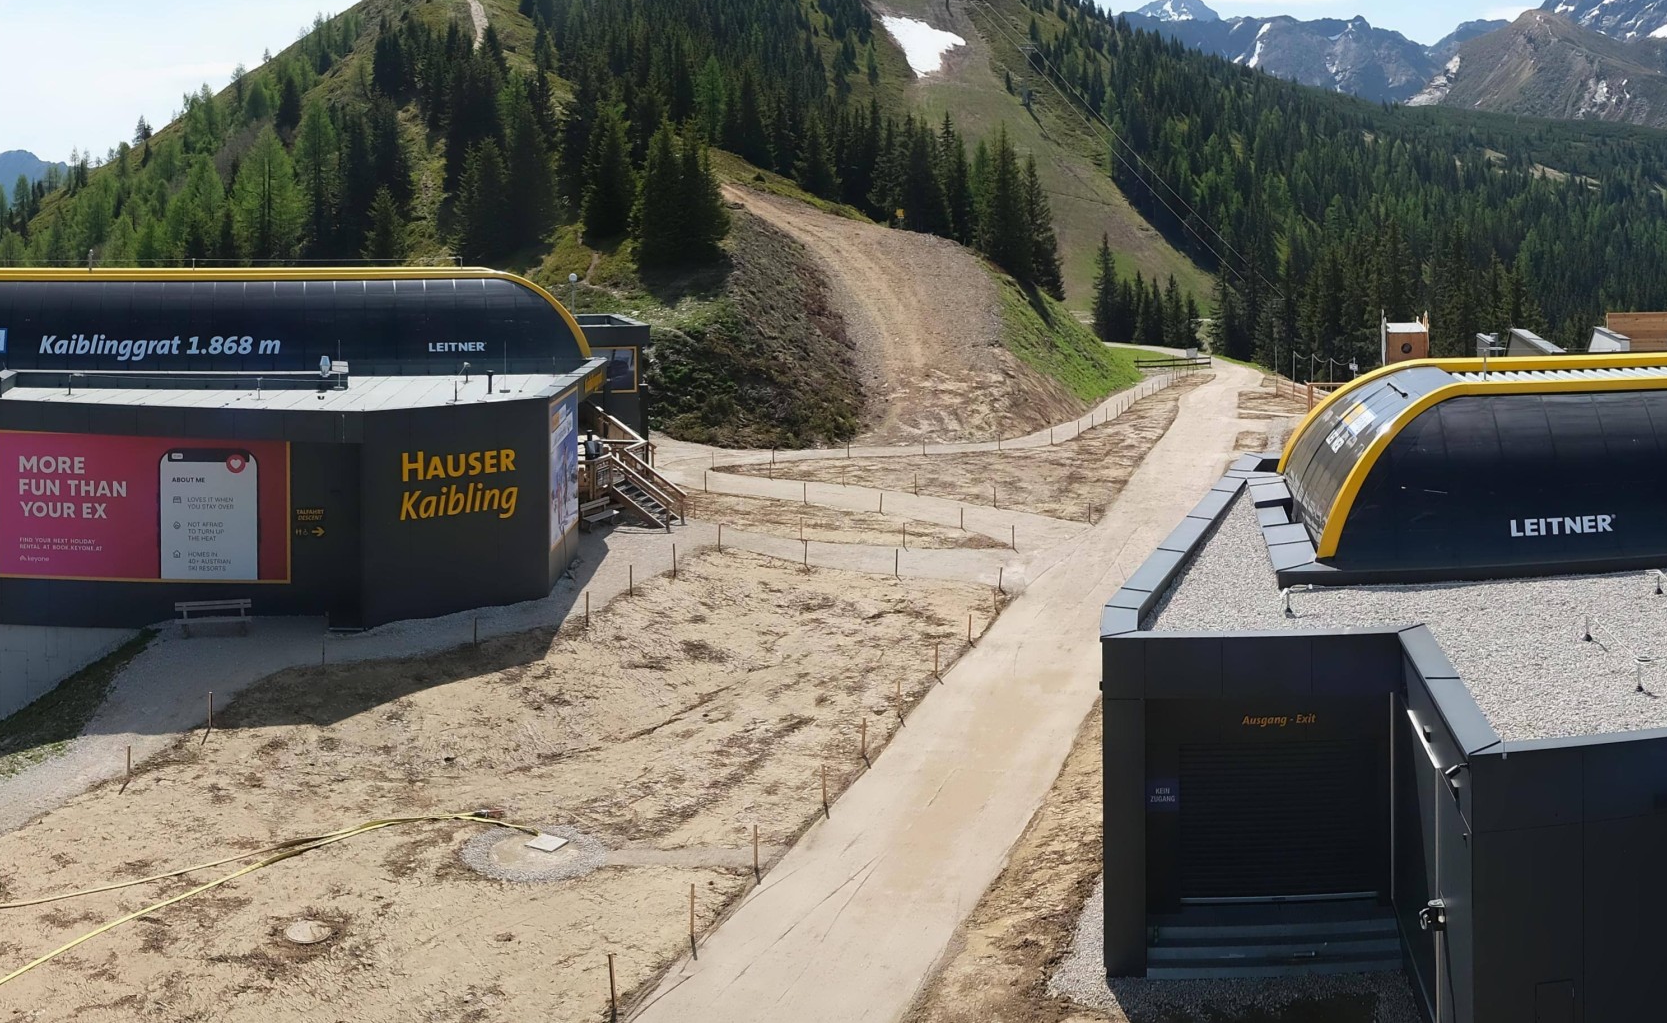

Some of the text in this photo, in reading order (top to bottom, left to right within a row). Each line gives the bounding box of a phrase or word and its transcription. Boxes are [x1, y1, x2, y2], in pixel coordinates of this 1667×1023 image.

[39, 334, 281, 360] Kaiblinggrat 1.868 m
[428, 341, 485, 352] LEITNER
[19, 456, 85, 474] MORE
[401, 449, 516, 482] HAUSER
[19, 478, 127, 497] FUN THAN
[20, 501, 107, 519] YOUR EX
[399, 482, 519, 521] Kaibling
[1510, 514, 1614, 537] LEITNER
[1242, 714, 1288, 727] Ausgang
[1296, 713, 1316, 724] Exit
[1155, 787, 1170, 795] KEIN
